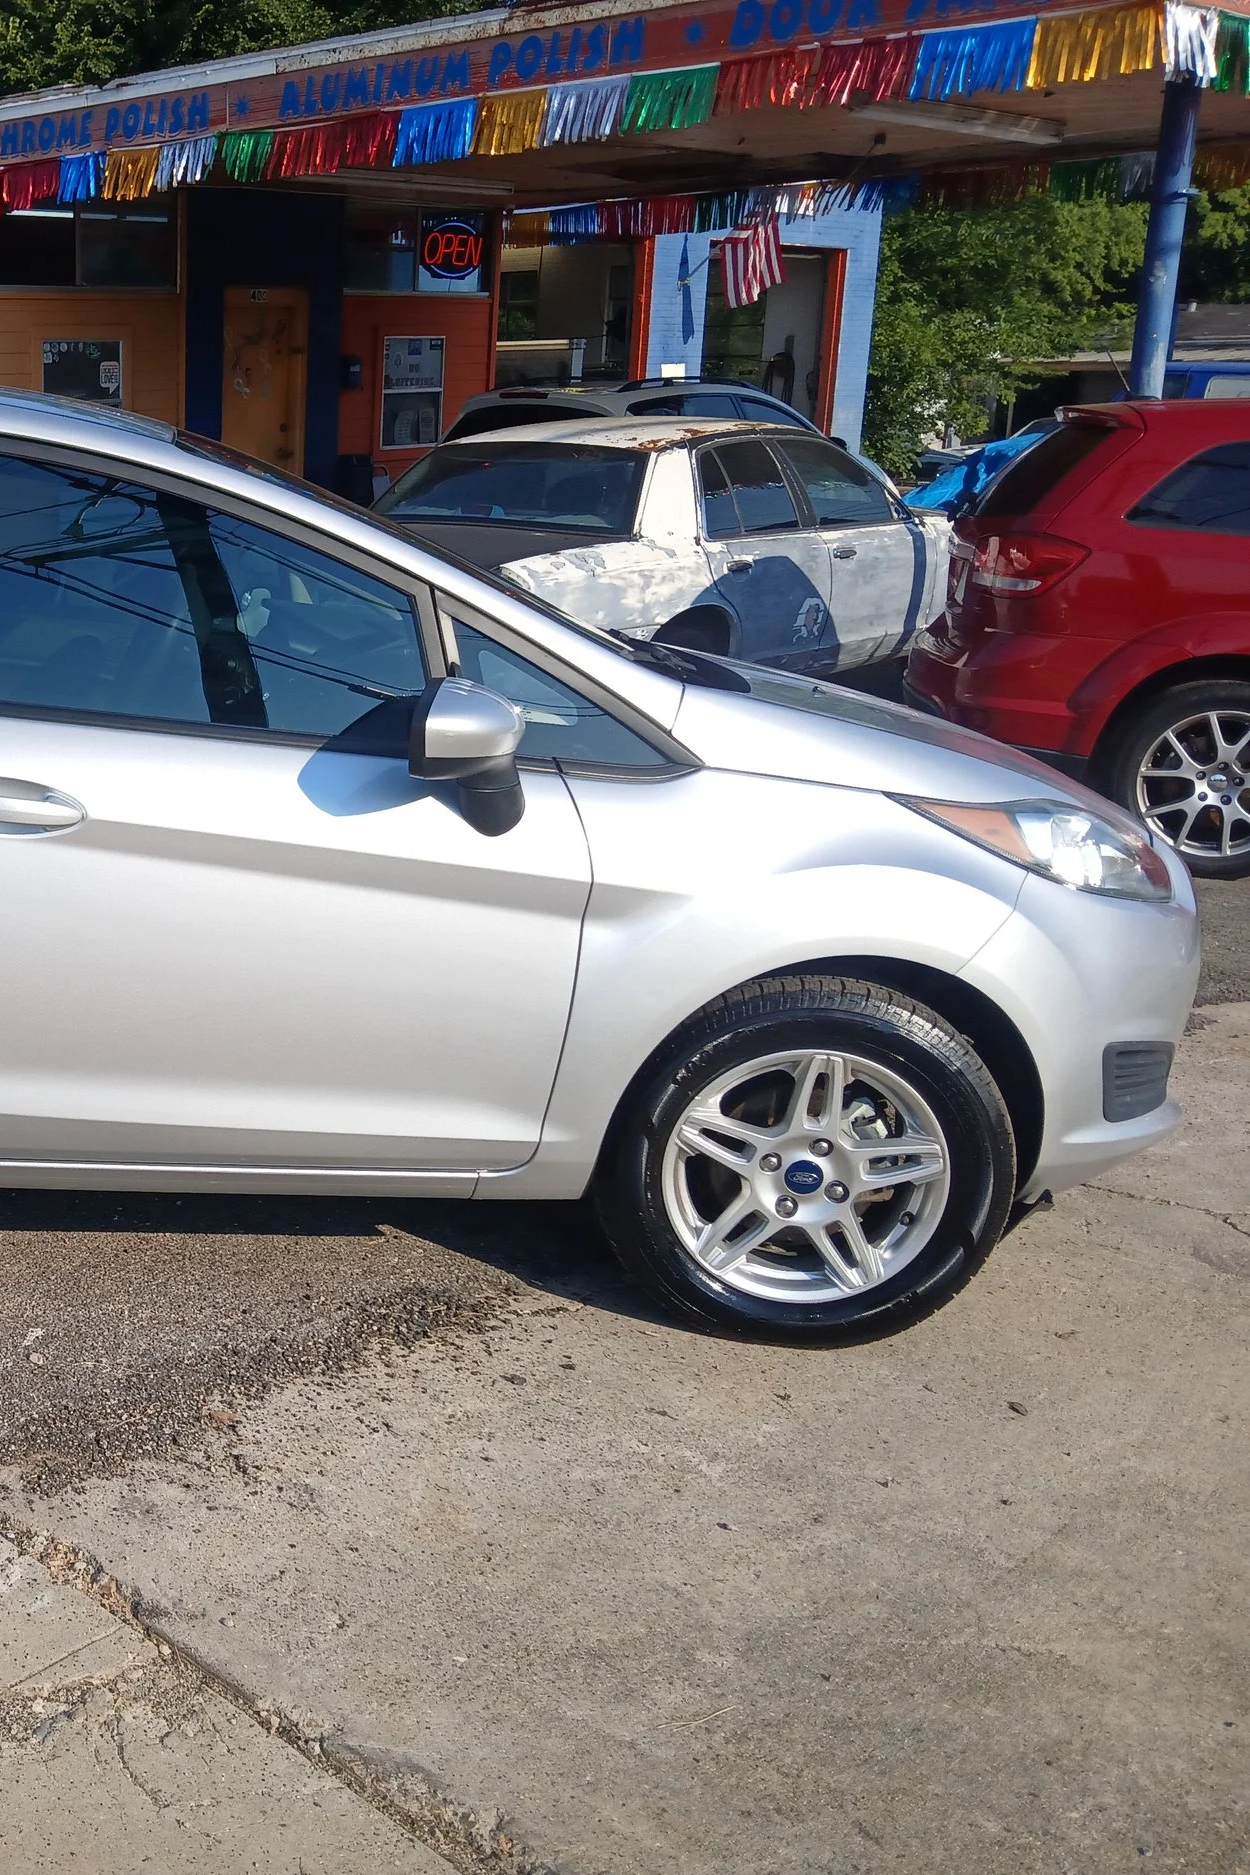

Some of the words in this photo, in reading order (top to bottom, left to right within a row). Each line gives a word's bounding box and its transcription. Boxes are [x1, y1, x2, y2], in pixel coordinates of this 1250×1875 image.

[278, 48, 473, 121] ALUMINUM
[488, 16, 647, 86] POLISH
[105, 92, 211, 145] POLISH
[424, 232, 483, 267] OPEN
